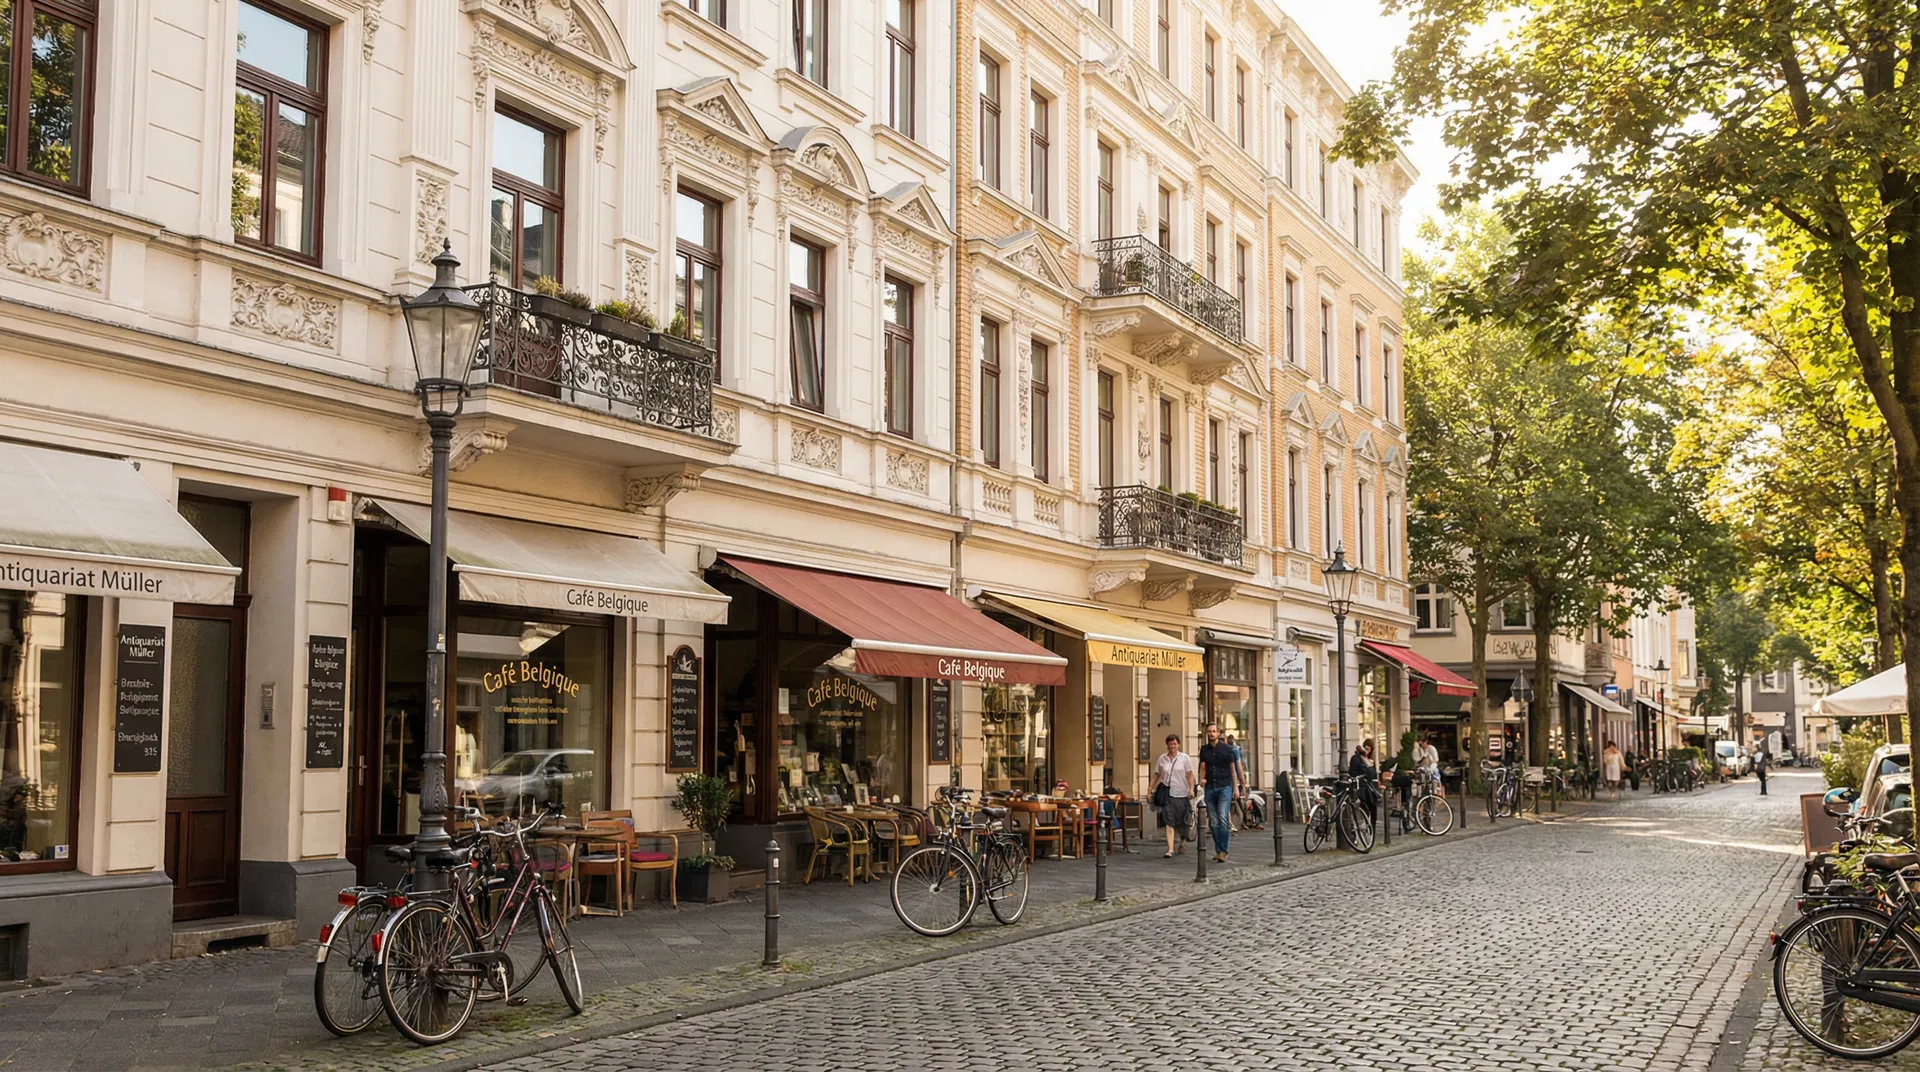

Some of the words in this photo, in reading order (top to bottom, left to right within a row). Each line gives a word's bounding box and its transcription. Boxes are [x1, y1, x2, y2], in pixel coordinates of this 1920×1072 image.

[0, 562, 96, 588] ntiquariat
[101, 569, 163, 593] Müller
[566, 588, 594, 607] Café
[597, 591, 649, 615] Belgique
[120, 634, 164, 648] Antiquariat
[938, 658, 961, 676] Café
[964, 660, 1006, 683] Belgique
[1161, 650, 1186, 669] Müller
[483, 662, 517, 694] Café
[520, 661, 580, 698] Belgique
[807, 678, 832, 708] Café
[834, 677, 877, 711] Belgique
